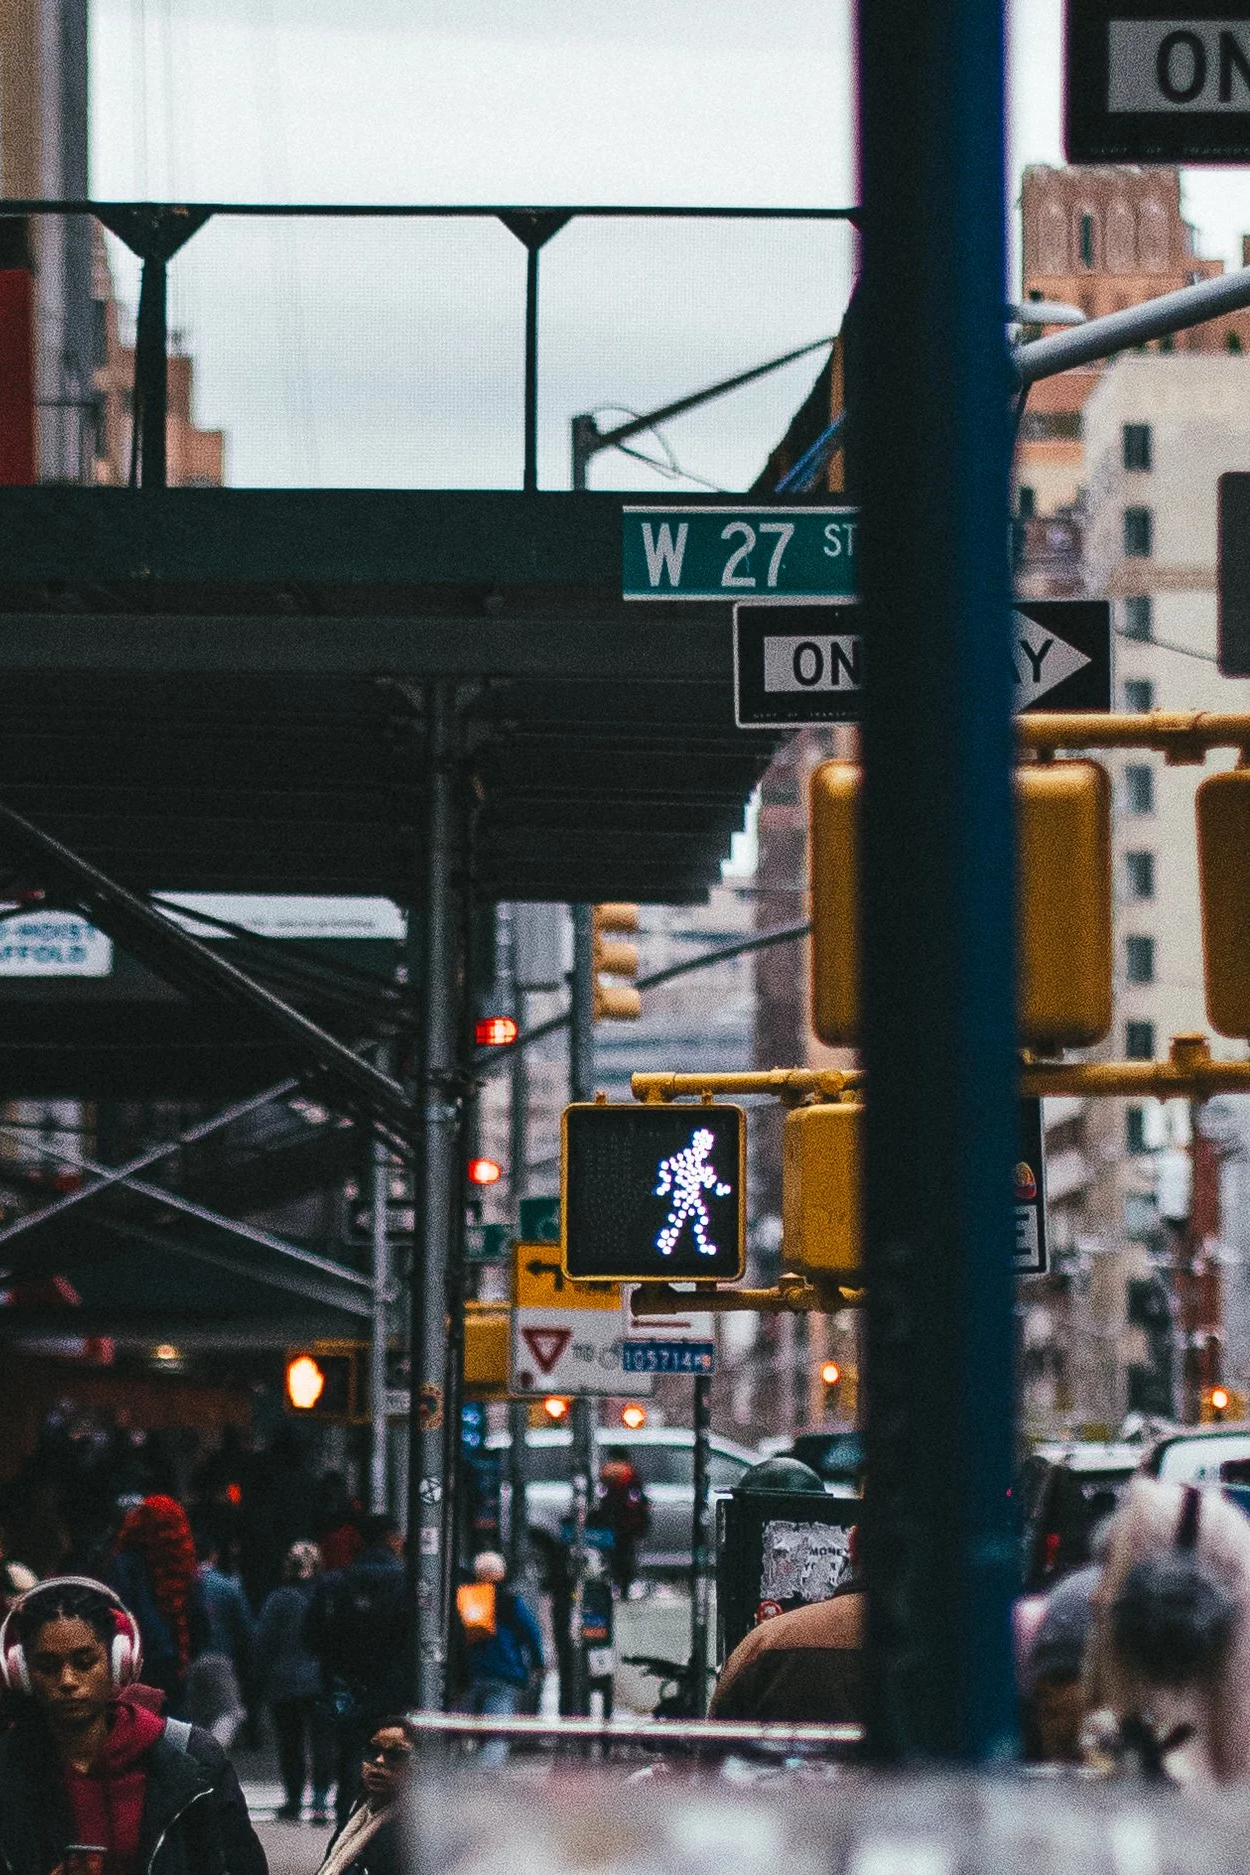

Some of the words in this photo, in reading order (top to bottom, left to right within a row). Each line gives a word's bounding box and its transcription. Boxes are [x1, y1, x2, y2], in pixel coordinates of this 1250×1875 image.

[1156, 30, 1250, 104] ON
[641, 522, 689, 587] W
[720, 521, 795, 588] 27
[823, 523, 857, 557] ST
[792, 641, 860, 686] ON
